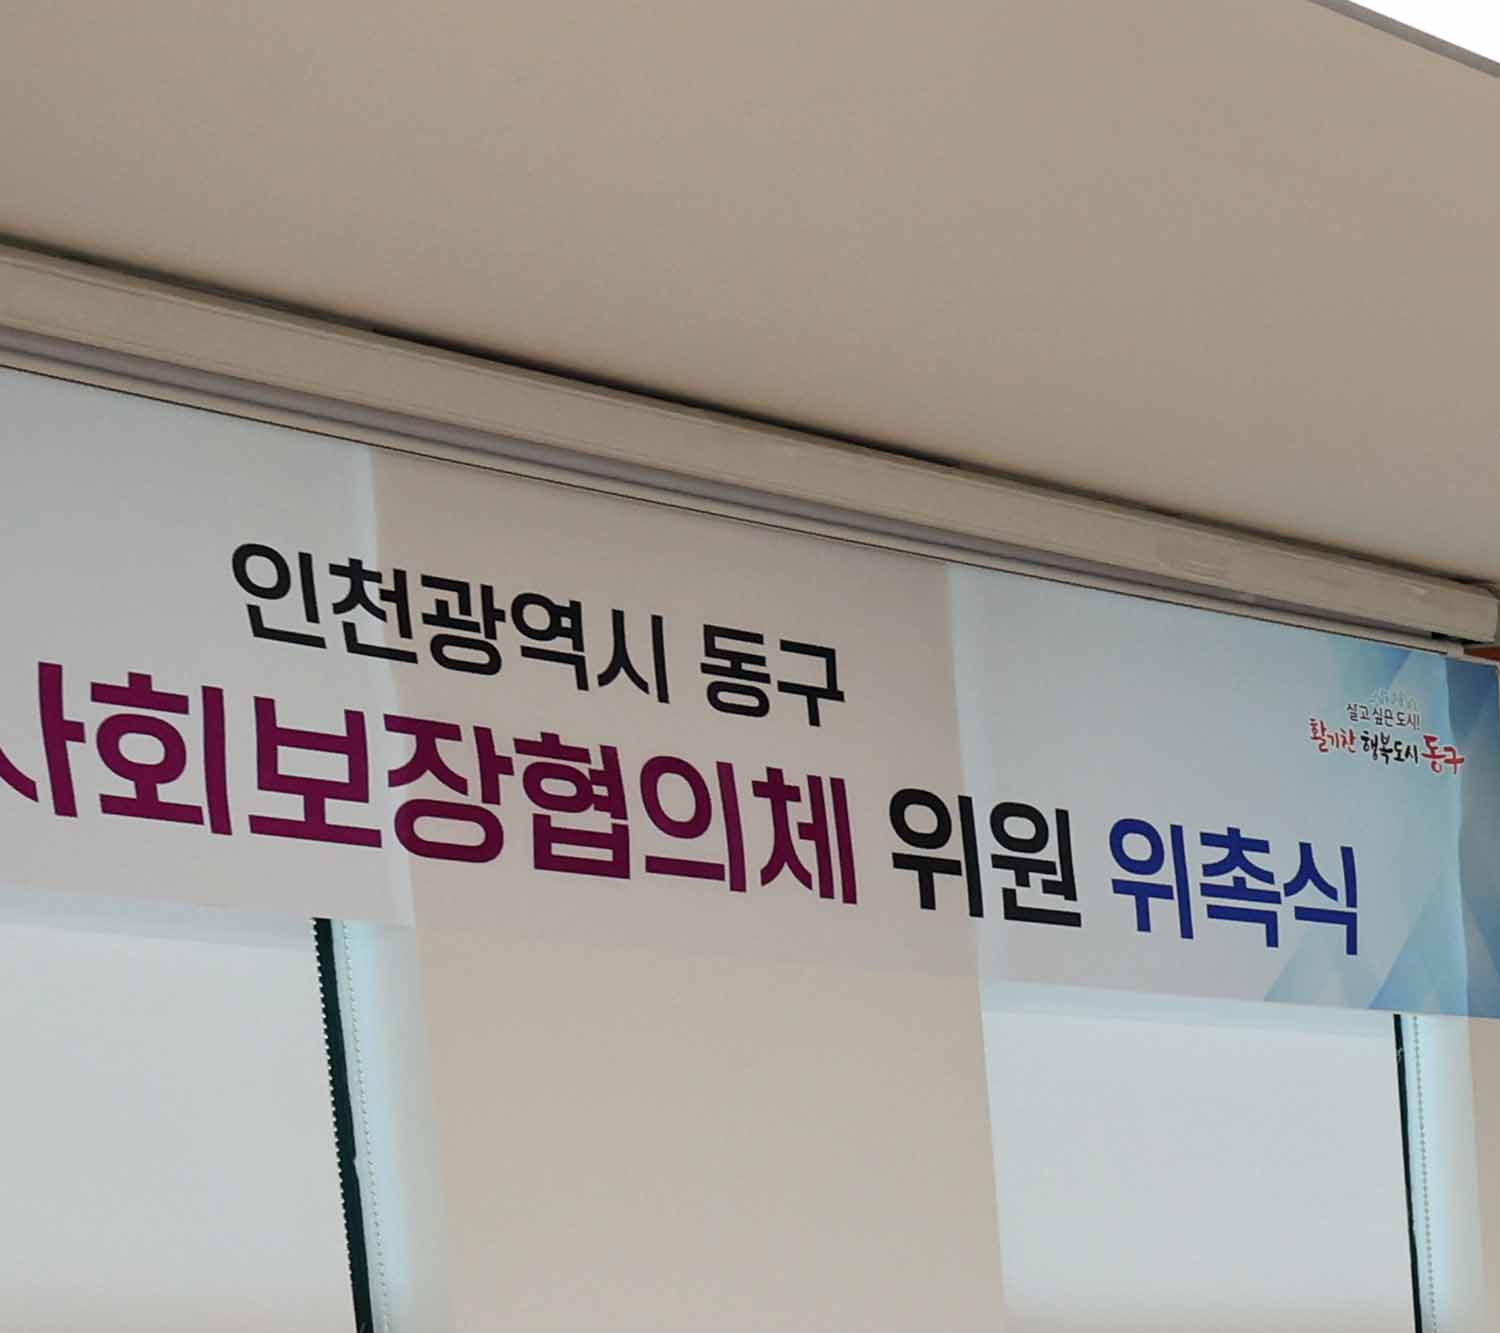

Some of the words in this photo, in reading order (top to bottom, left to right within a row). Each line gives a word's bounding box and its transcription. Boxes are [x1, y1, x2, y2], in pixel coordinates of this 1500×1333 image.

[231, 543, 668, 703] 인천광역시
[699, 622, 847, 728] 동구
[1309, 718, 1357, 753] 활기찬
[1361, 730, 1419, 765] 행복도시
[1420, 734, 1466, 775] 동구
[888, 788, 1082, 928] 위원
[1108, 816, 1361, 955] 위촉식
